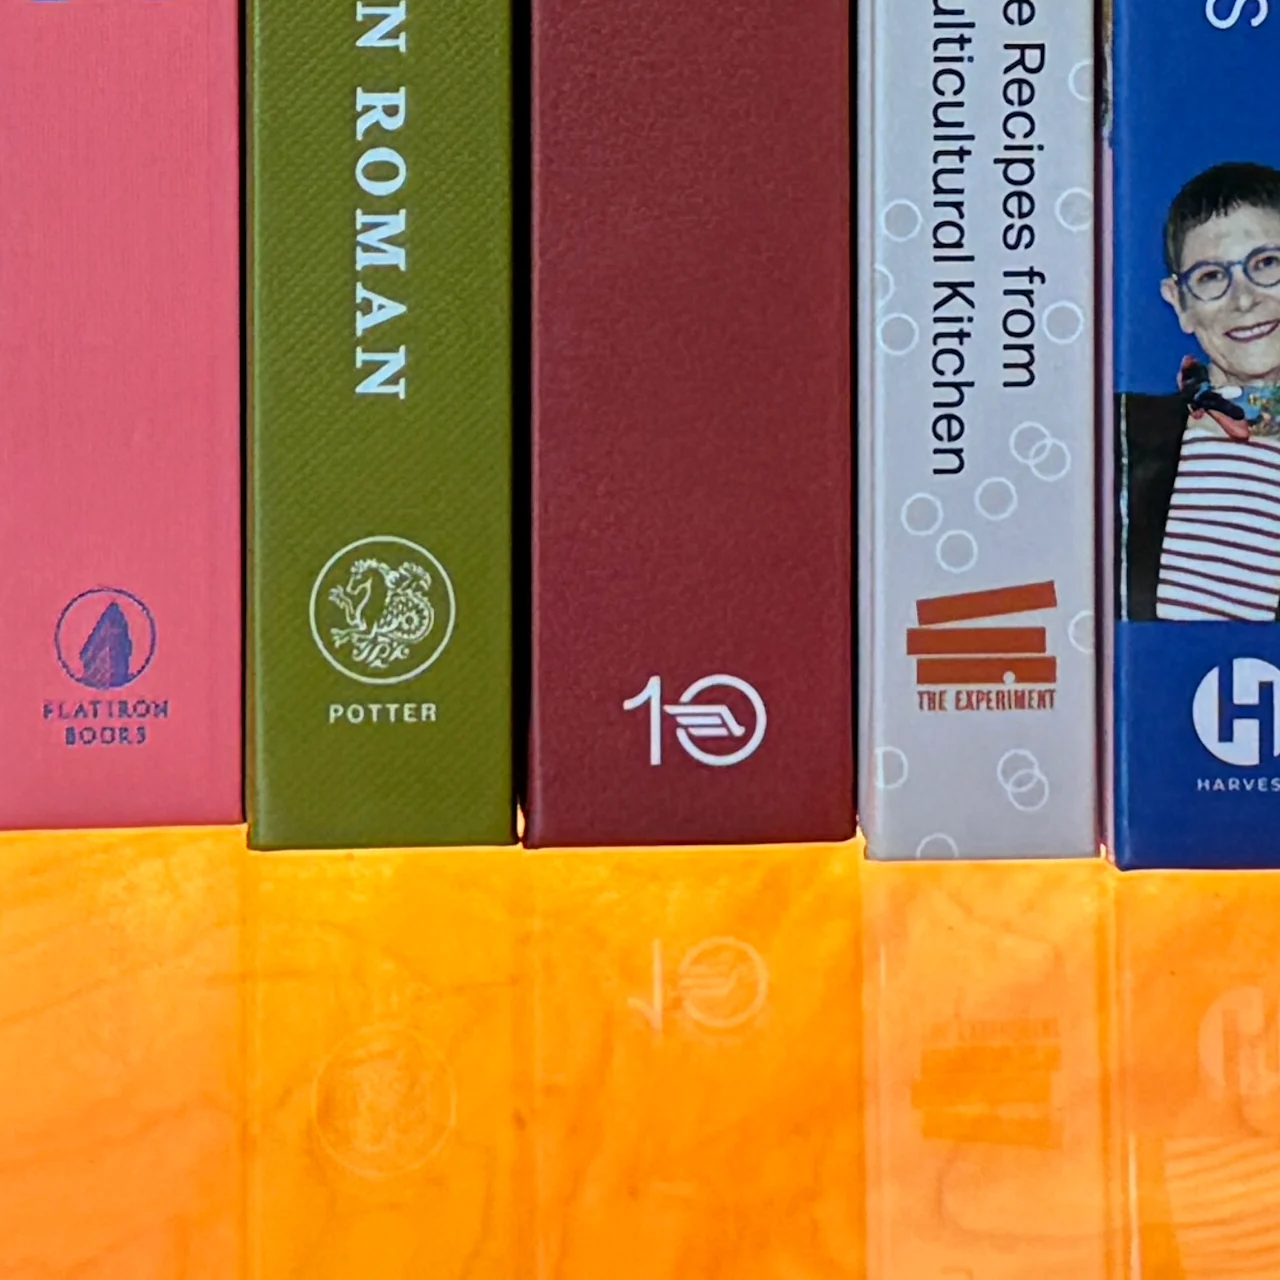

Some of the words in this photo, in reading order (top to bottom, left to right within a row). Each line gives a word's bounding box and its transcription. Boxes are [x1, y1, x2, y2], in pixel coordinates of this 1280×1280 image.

[992, 42, 1048, 251] Recipes
[353, 84, 409, 401] ROMAN
[1002, 266, 1048, 390] from
[931, 275, 976, 477] Kitchen
[43, 700, 168, 719] FLATIRON
[65, 726, 147, 745] BOOKS
[328, 702, 437, 724] POTTER
[916, 690, 948, 712] THE
